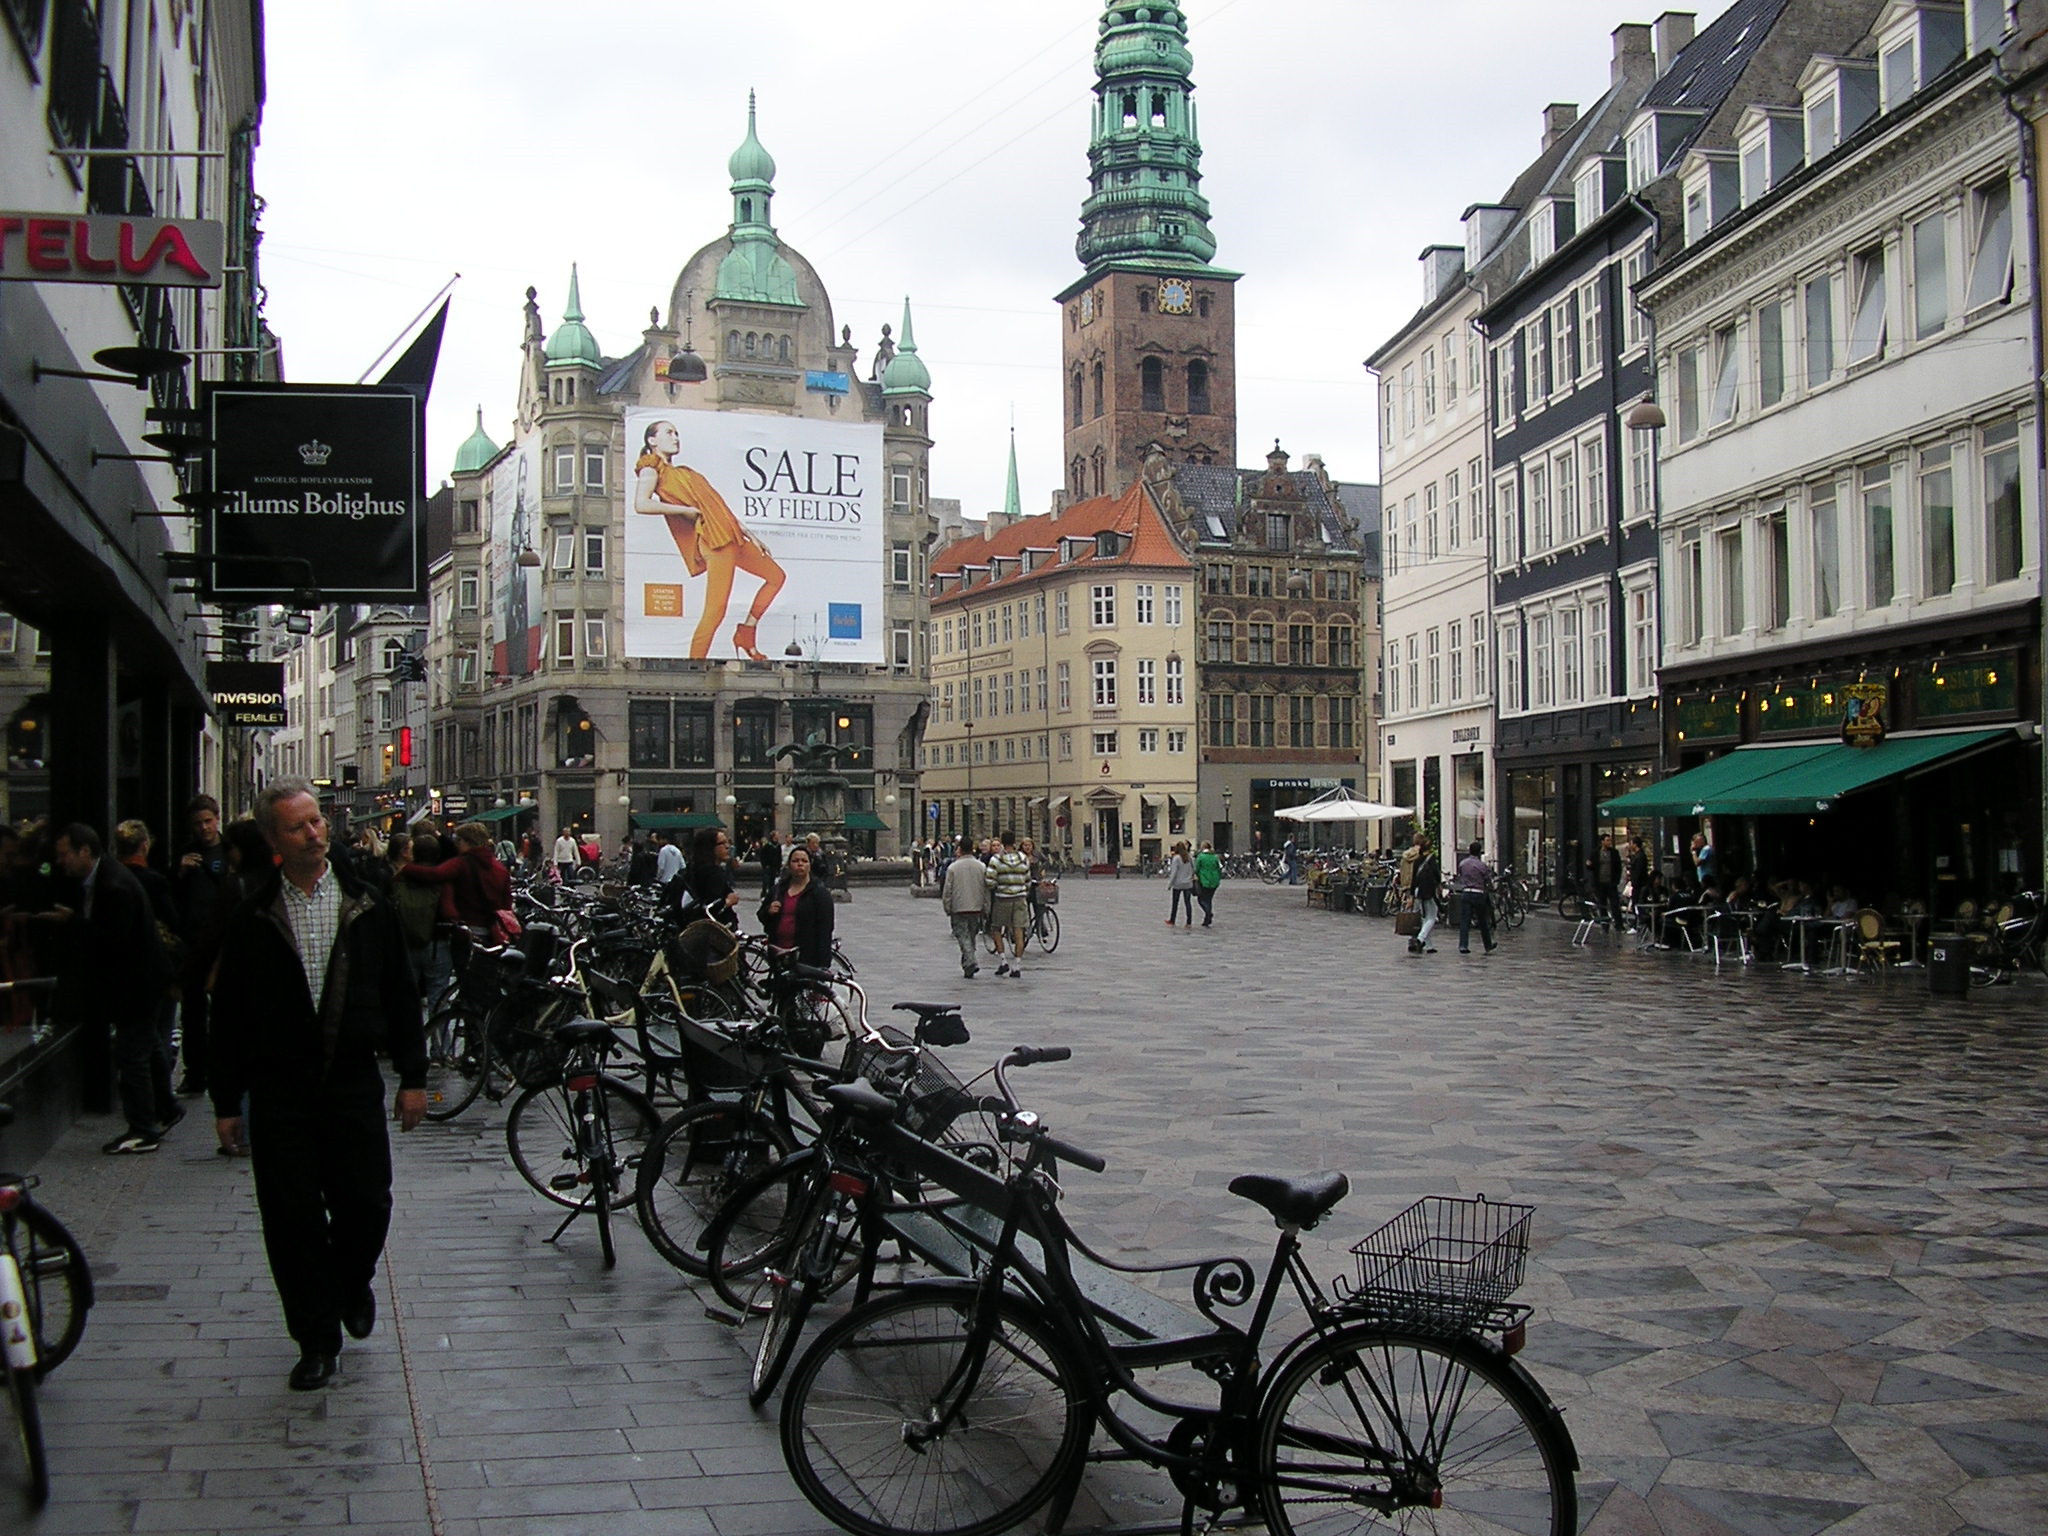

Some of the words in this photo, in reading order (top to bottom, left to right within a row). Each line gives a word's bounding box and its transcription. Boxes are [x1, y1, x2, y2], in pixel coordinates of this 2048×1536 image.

[254, 476, 298, 485] KONGELIG
[300, 477, 373, 486] HOFLEVERANDØR
[742, 447, 863, 498] SALE
[303, 491, 406, 520] Bolighus
[744, 496, 770, 518] BY
[779, 498, 862, 523] FIELD'S
[235, 713, 285, 723] FEMILET
[1269, 779, 1309, 787] Danske
